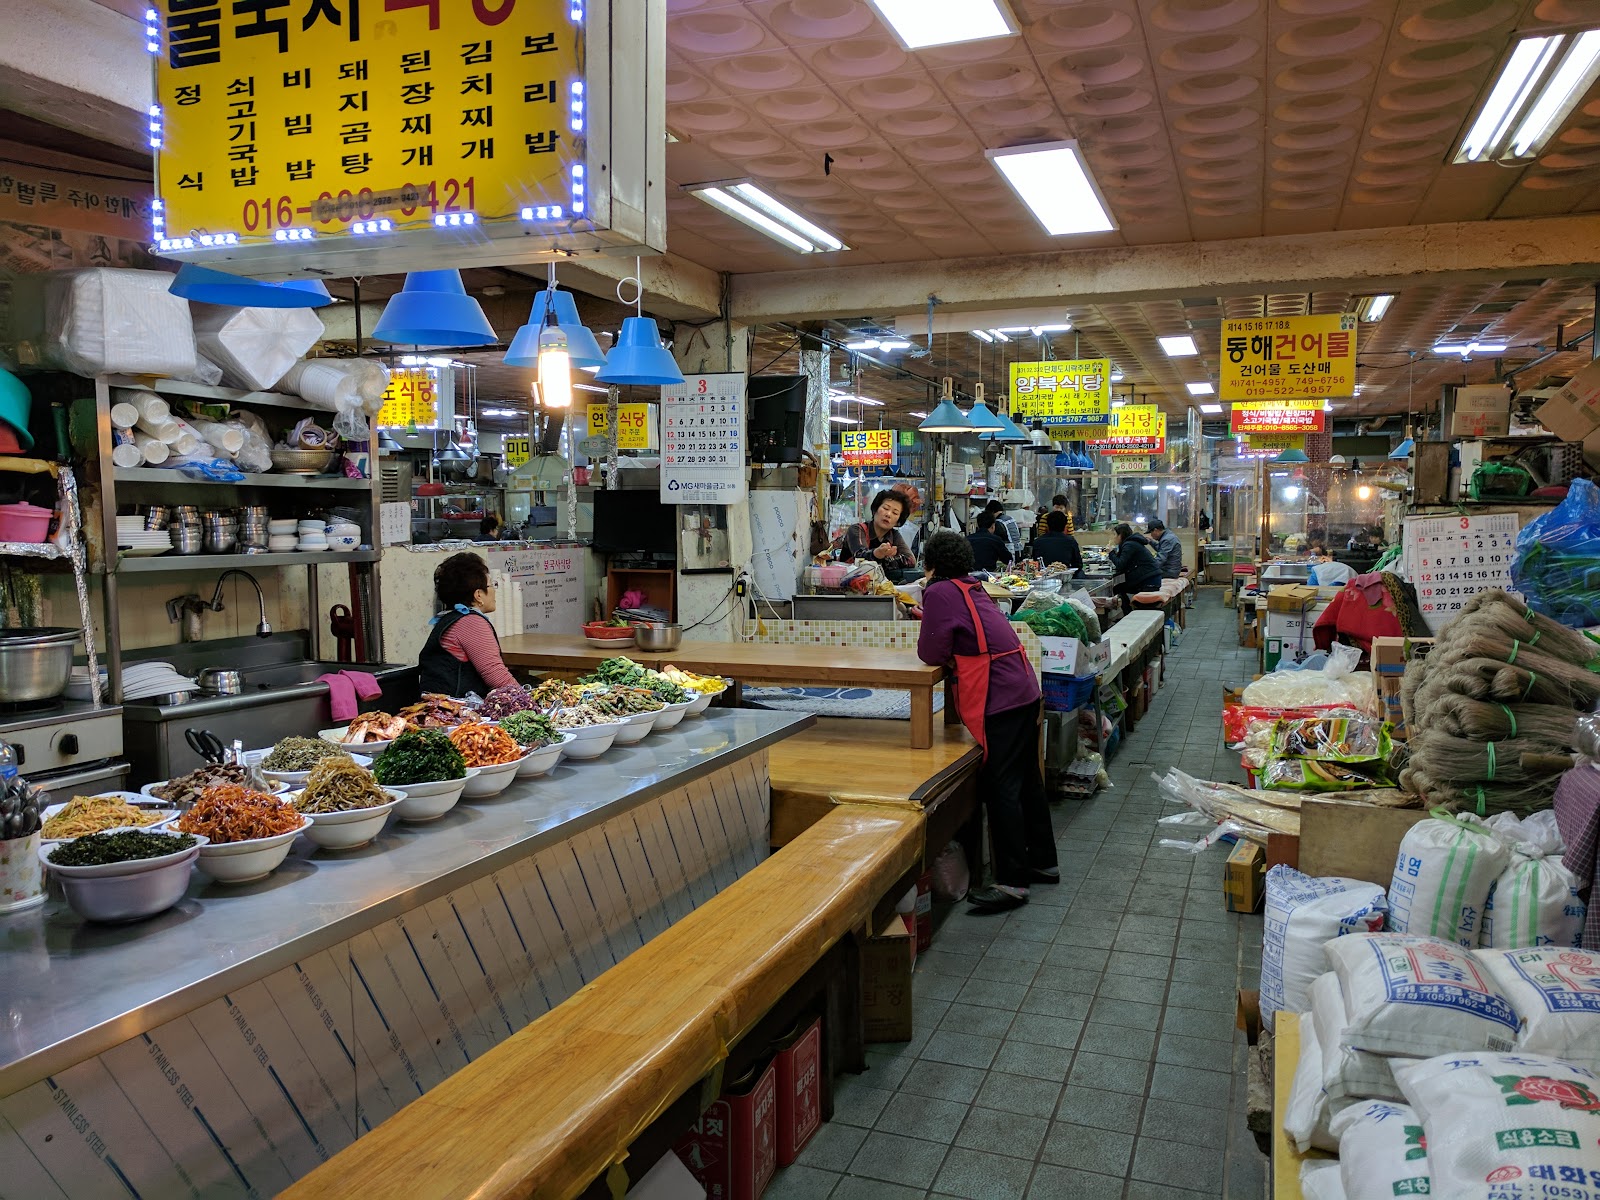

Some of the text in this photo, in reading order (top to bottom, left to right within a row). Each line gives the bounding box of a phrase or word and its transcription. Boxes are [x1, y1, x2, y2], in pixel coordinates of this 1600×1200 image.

[1227, 332, 1349, 363] 동해건어물
[1240, 362, 1331, 377] 건어물 도산매
[698, 380, 707, 393] 3
[1015, 374, 1104, 393] 양북식당
[1296, 376, 1345, 385] 749-6756
[1246, 386, 1332, 396] 019-522-4957
[844, 432, 891, 448] 보영식당
[754, 514, 763, 533] posco
[773, 506, 784, 527] posco
[1460, 517, 1469, 529] 3
[300, 973, 334, 1031] STAINLESS STEEL
[1458, 997, 1511, 1022] 962-8500
[230, 1006, 270, 1068] STAINLESS STEEL
[149, 1044, 194, 1109] STAINLESS STEEL
[53, 1088, 106, 1158] STAINLESS STEEL
[1503, 1130, 1573, 1145] 식용소금
